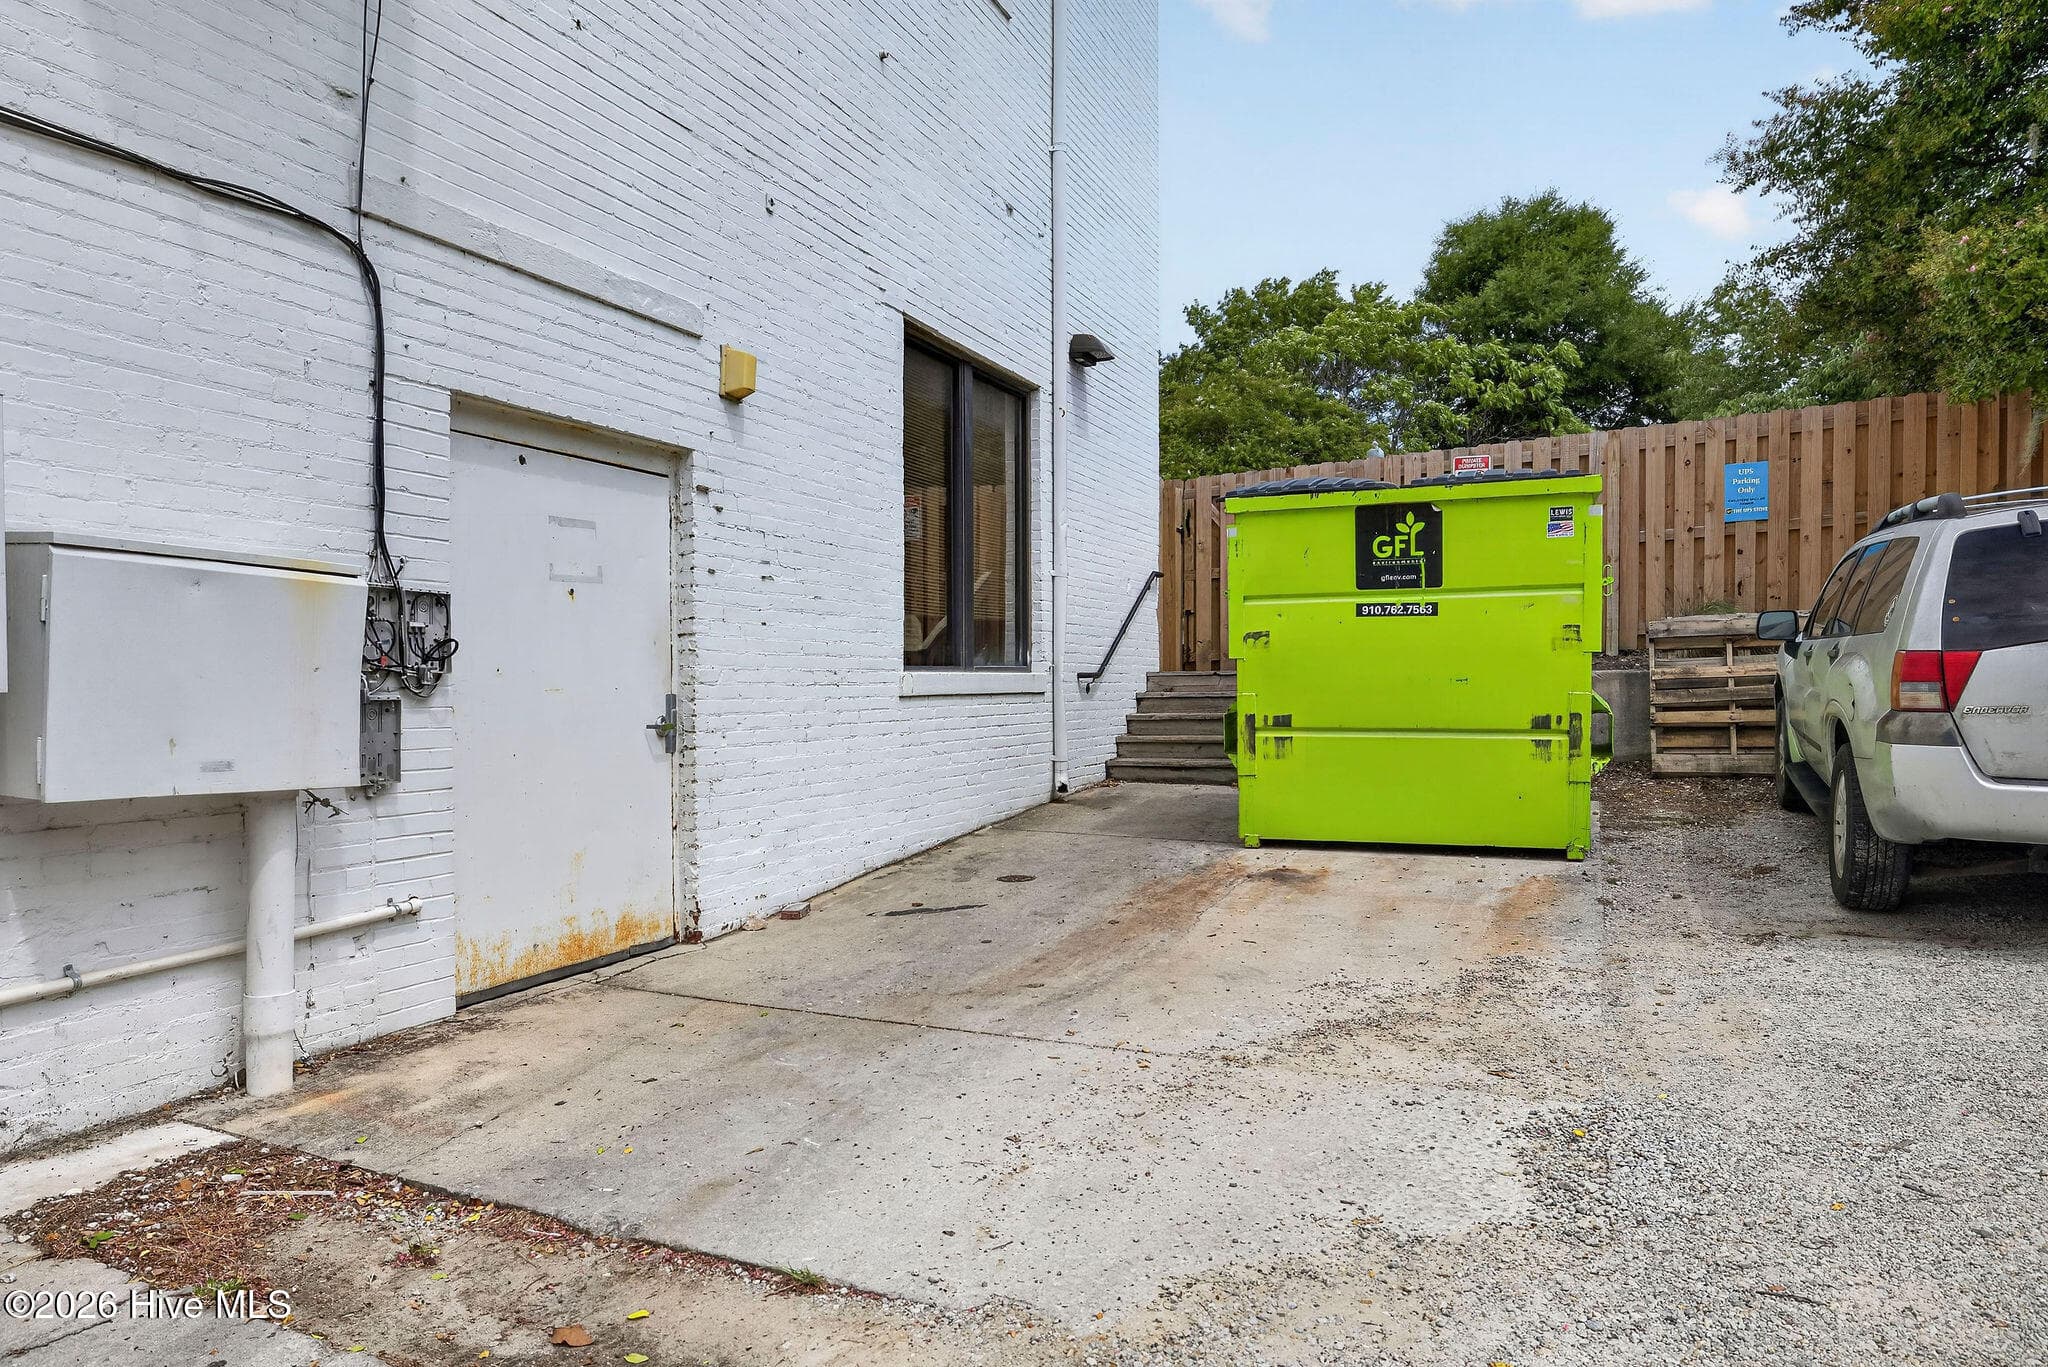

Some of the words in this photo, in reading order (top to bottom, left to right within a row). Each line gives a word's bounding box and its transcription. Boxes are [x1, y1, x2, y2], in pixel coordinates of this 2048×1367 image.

[1732, 477, 1761, 485] Parking
[1737, 486, 1755, 494] Only
[1550, 508, 1573, 516] LEWIS
[1372, 521, 1425, 558] GFL
[1362, 604, 1433, 615] 910.762.7563
[1963, 704, 2030, 715] ENDEAVOR
